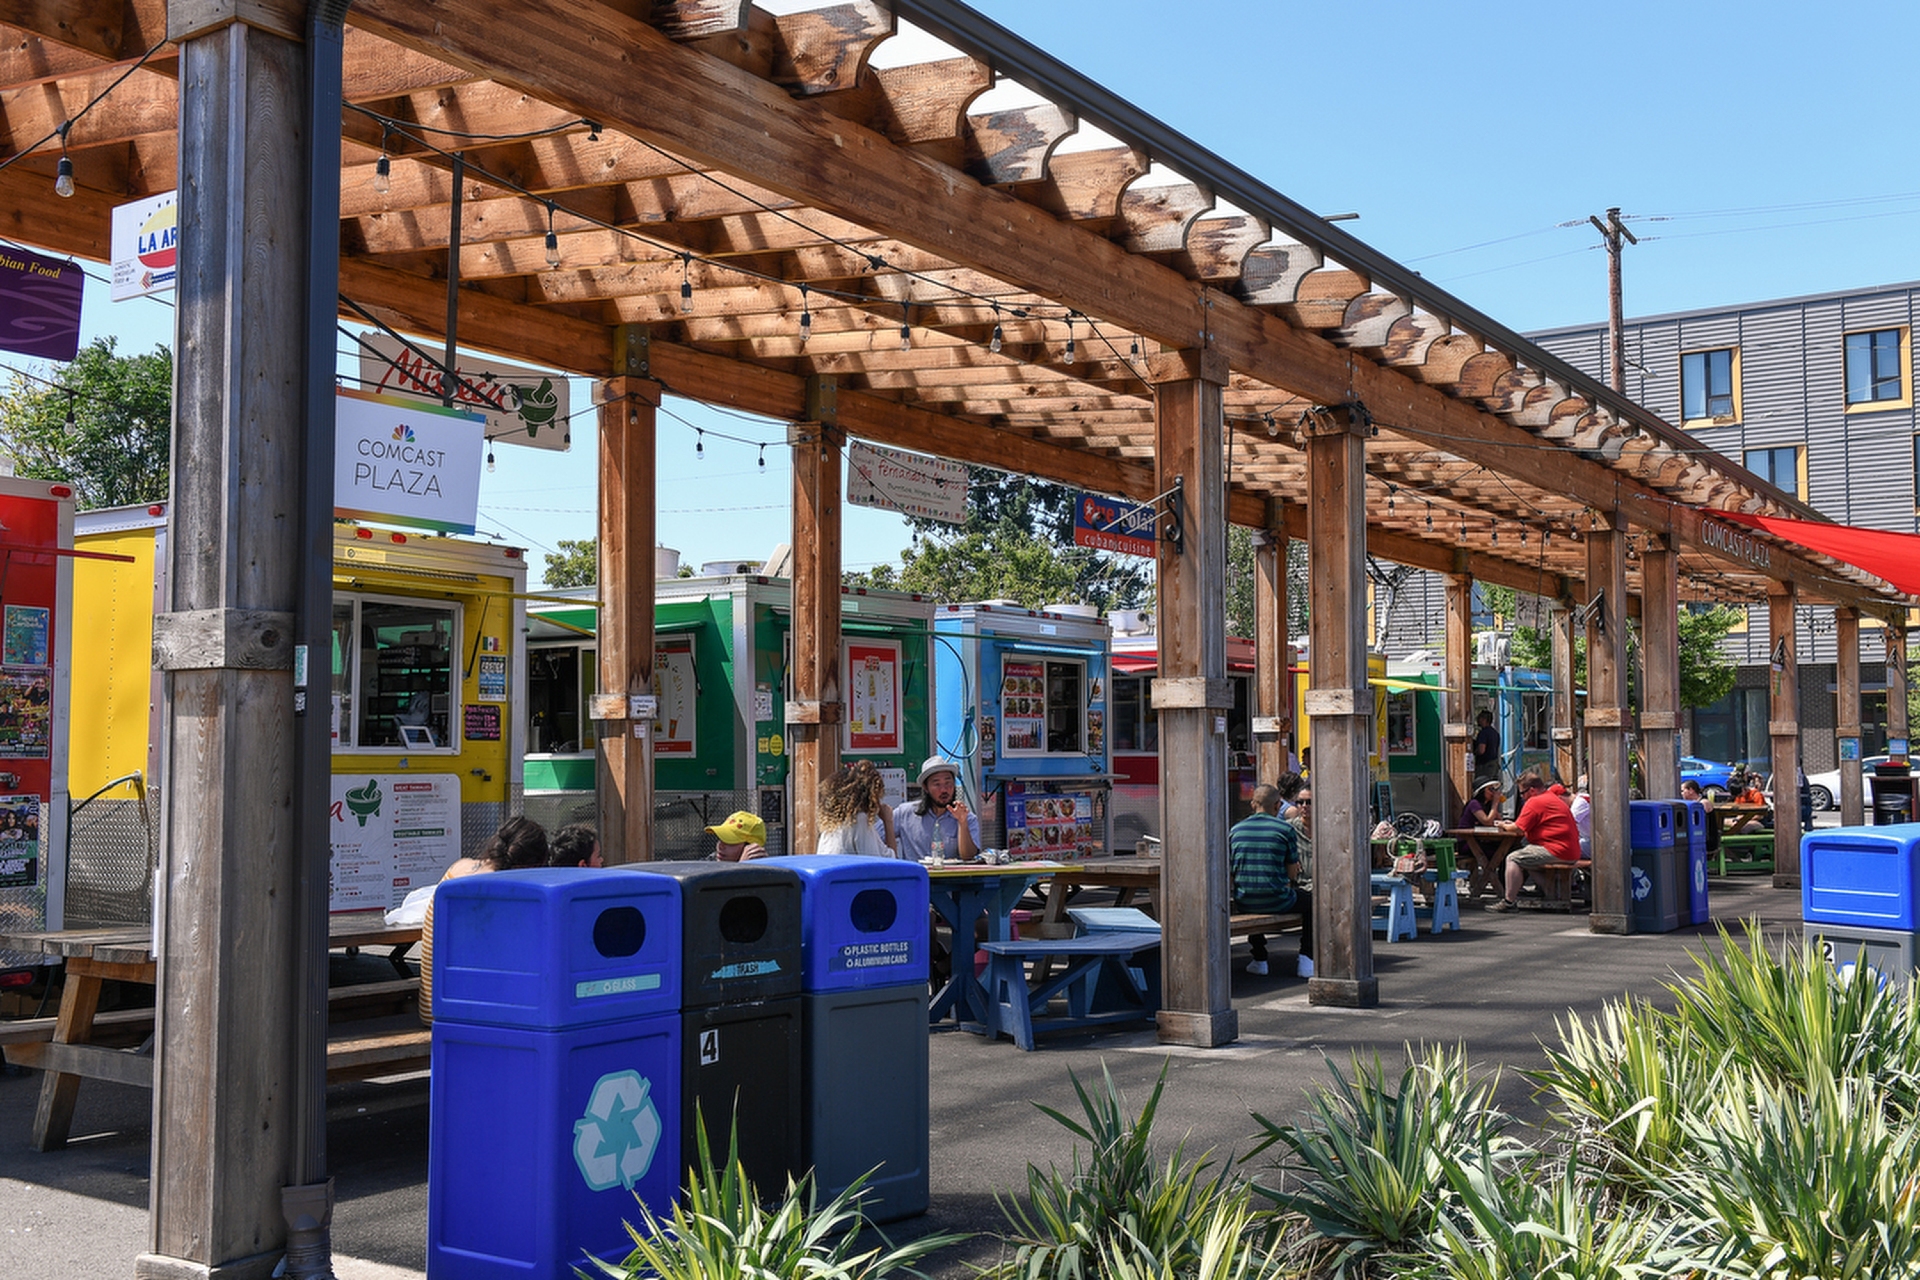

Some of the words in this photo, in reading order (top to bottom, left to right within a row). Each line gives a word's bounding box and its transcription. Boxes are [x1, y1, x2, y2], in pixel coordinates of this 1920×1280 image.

[138, 231, 157, 254] LA
[29, 261, 62, 279] Food
[357, 438, 446, 468] COMCAST
[354, 462, 442, 498] PLAZA
[1084, 533, 1116, 549] cuban
[1118, 540, 1151, 557] cuisine
[1702, 519, 1744, 558] COMCAST
[1745, 538, 1771, 569] PLAZA
[852, 944, 879, 956] PLASTIC
[880, 941, 909, 953] BOTTLES
[1822, 942, 1833, 962] 2
[854, 955, 890, 968] ALUMINUM
[891, 953, 908, 964] CANS
[612, 978, 636, 992] GLASS
[702, 1031, 717, 1061] 4
